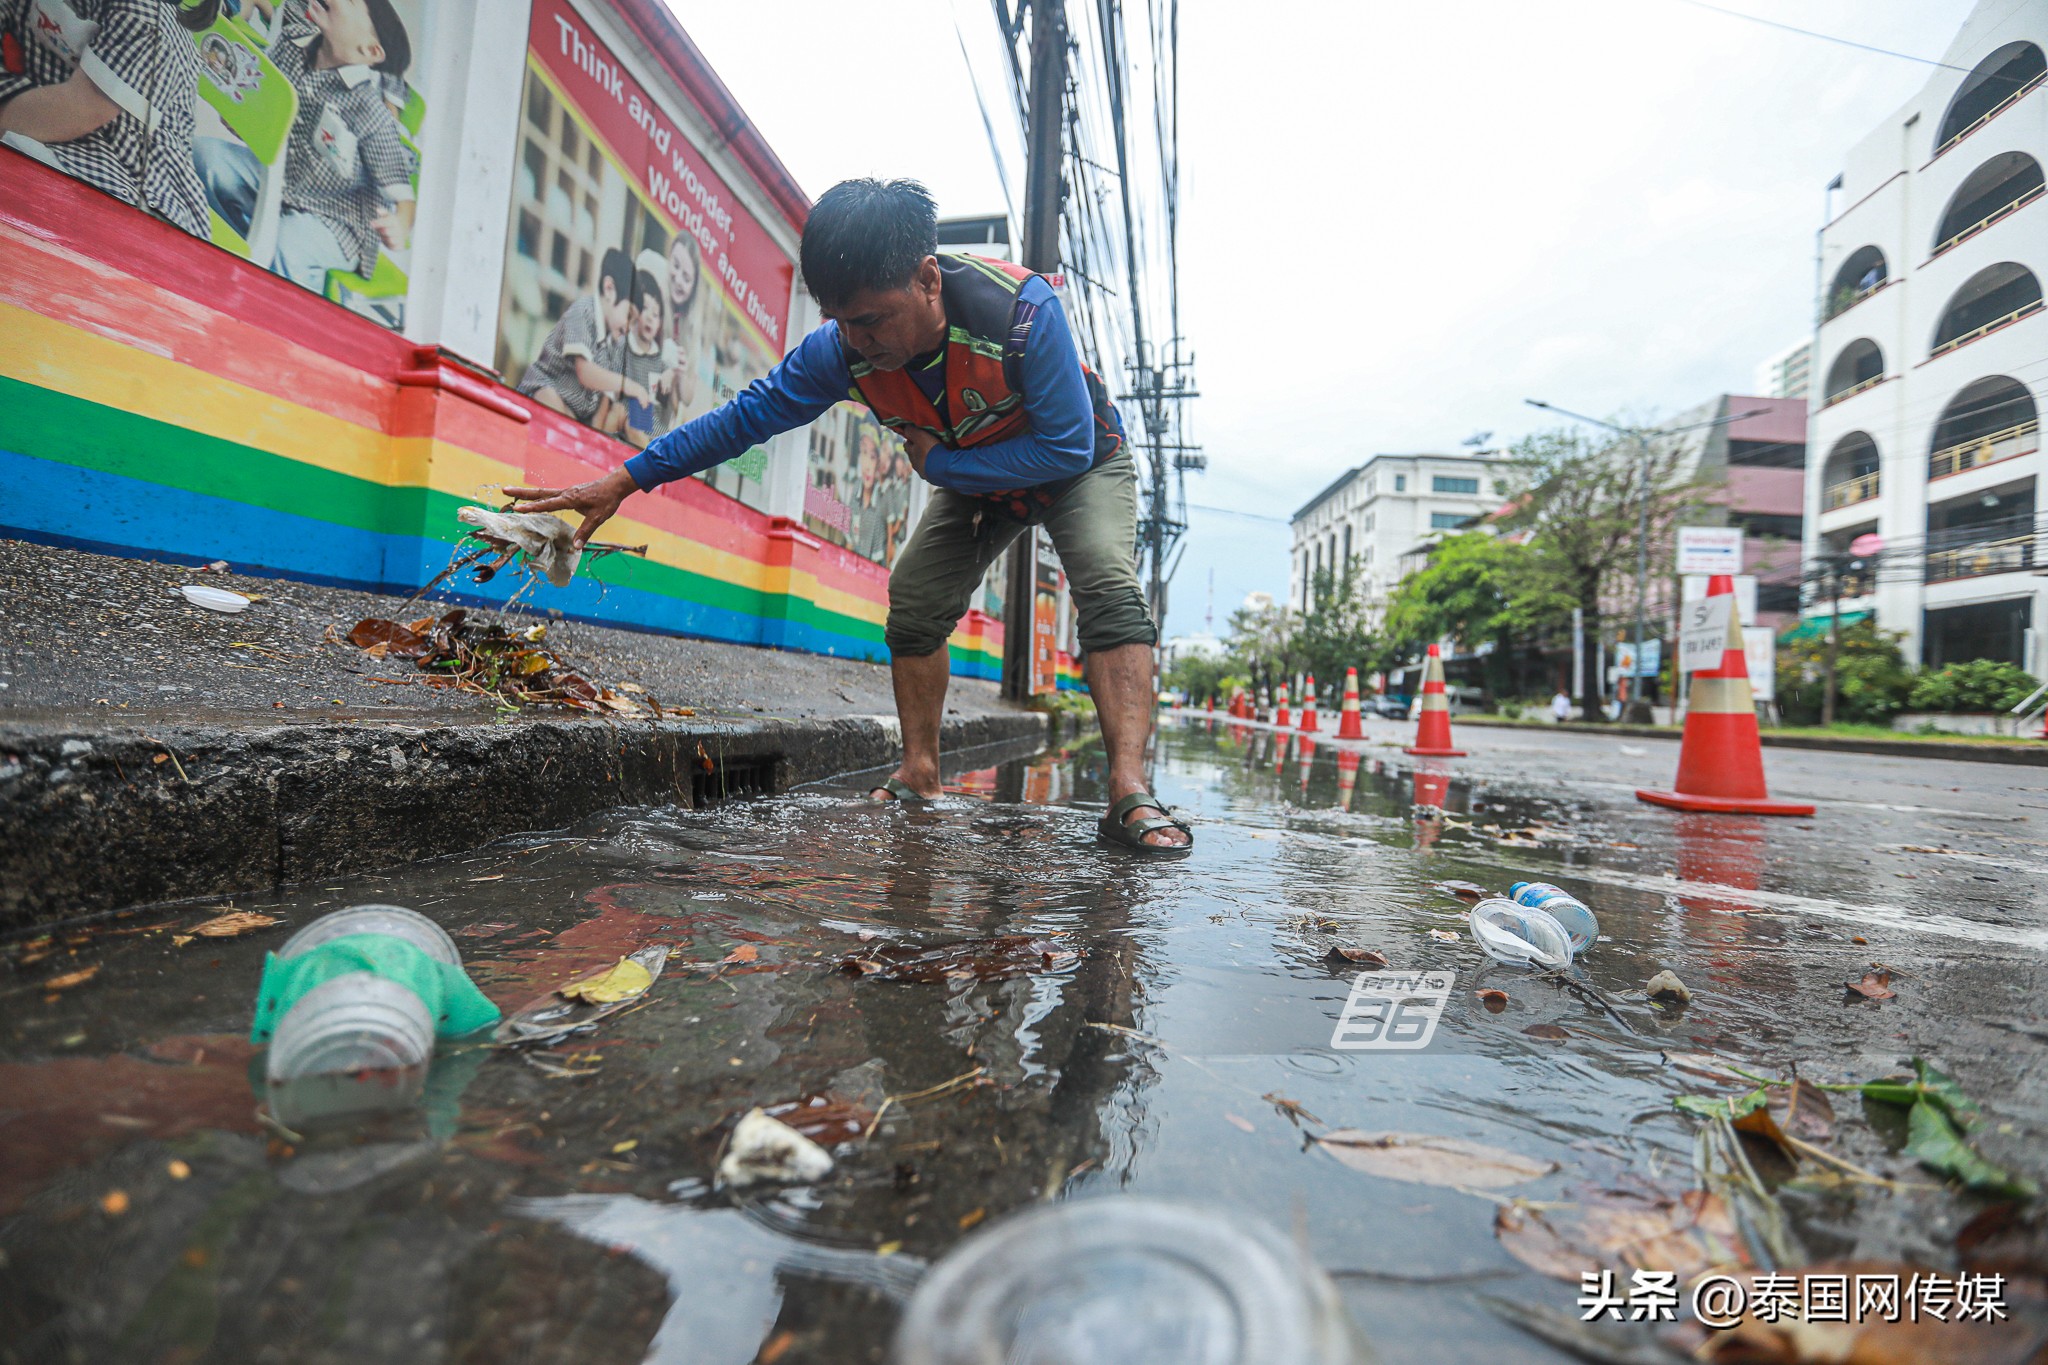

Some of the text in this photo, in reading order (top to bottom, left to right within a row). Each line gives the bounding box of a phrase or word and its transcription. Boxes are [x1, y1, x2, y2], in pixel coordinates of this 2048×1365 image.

[553, 13, 735, 243] Think and wonder,
[647, 165, 779, 341] Wonder and think
